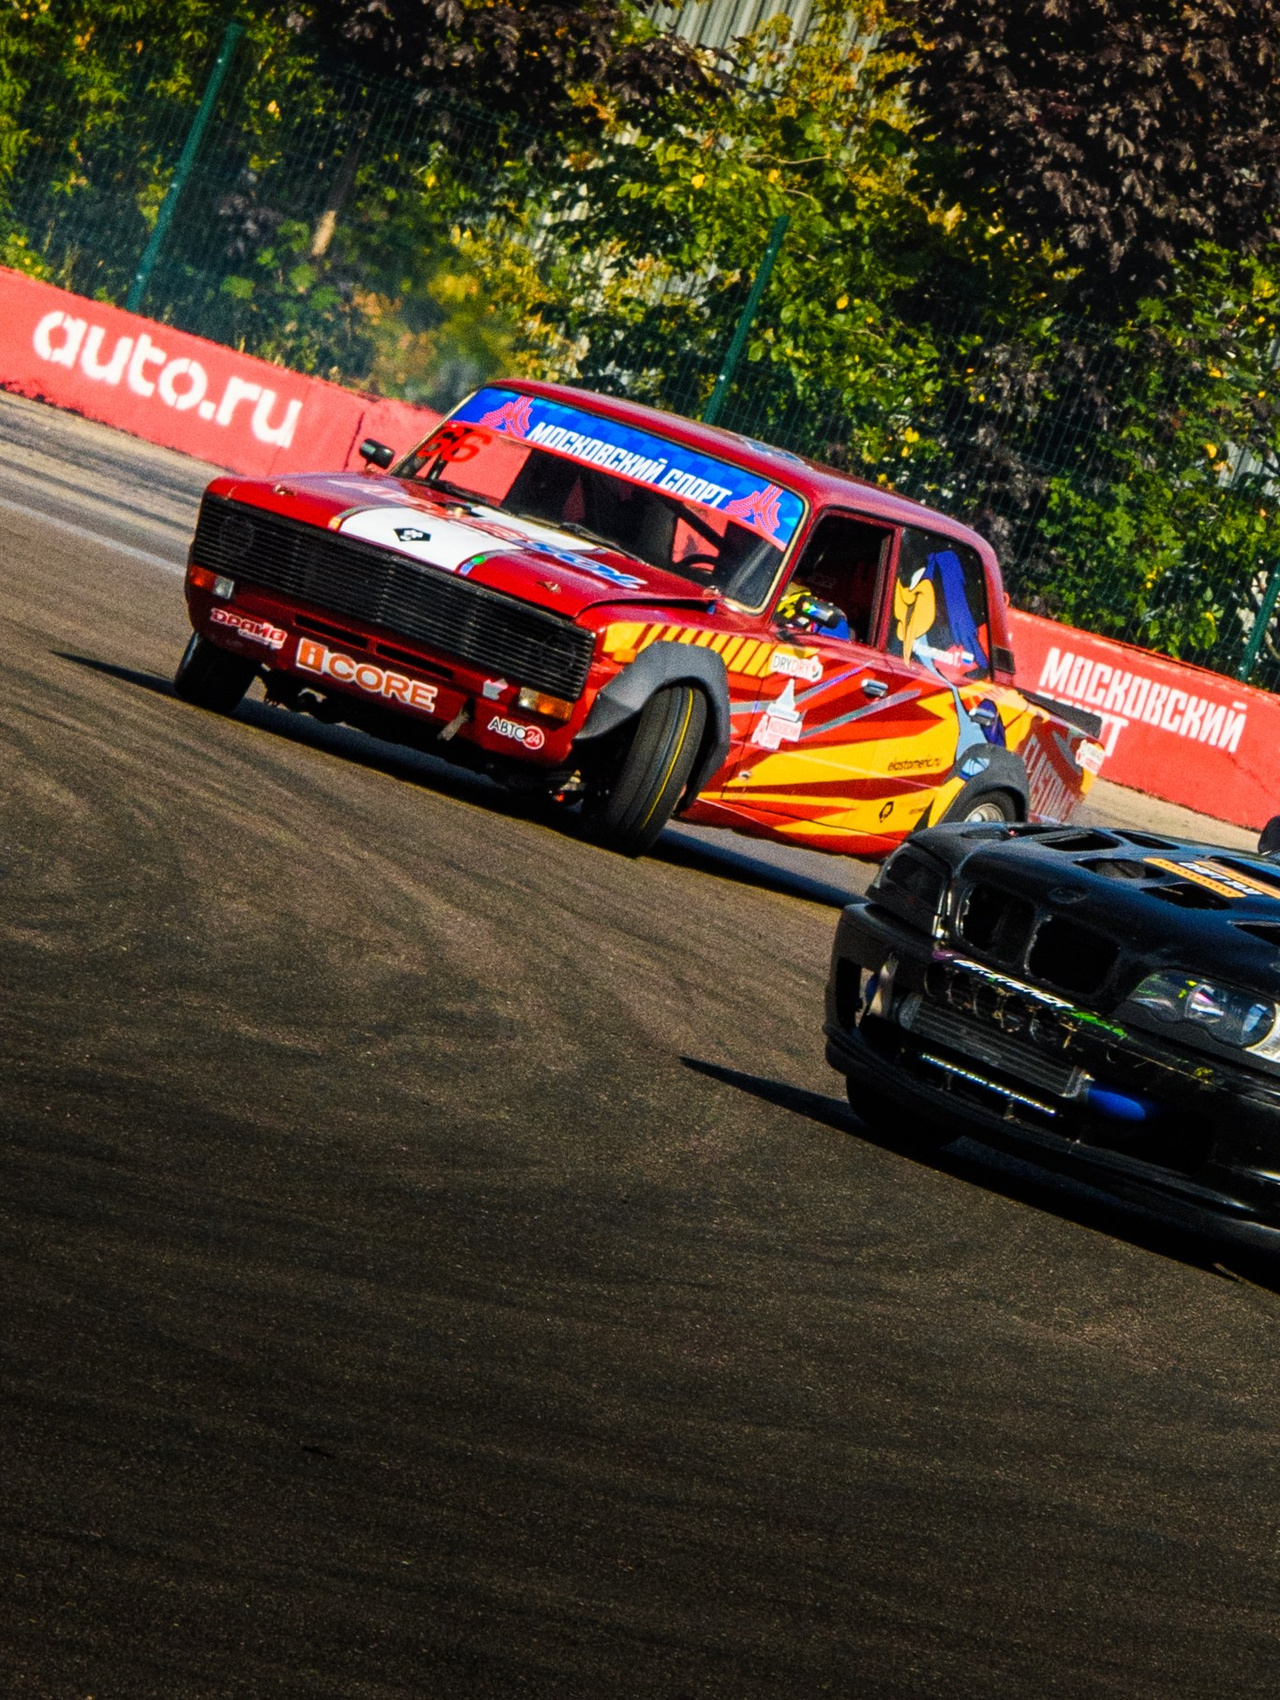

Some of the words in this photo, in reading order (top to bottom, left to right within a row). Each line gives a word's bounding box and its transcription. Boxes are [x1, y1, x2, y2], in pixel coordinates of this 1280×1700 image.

[33, 310, 303, 449] auto.ru
[526, 421, 668, 484] МОСКОВСКИЙ
[658, 467, 733, 508] СПОРТ
[1038, 647, 1247, 752] МОСКОВСКИЙ
